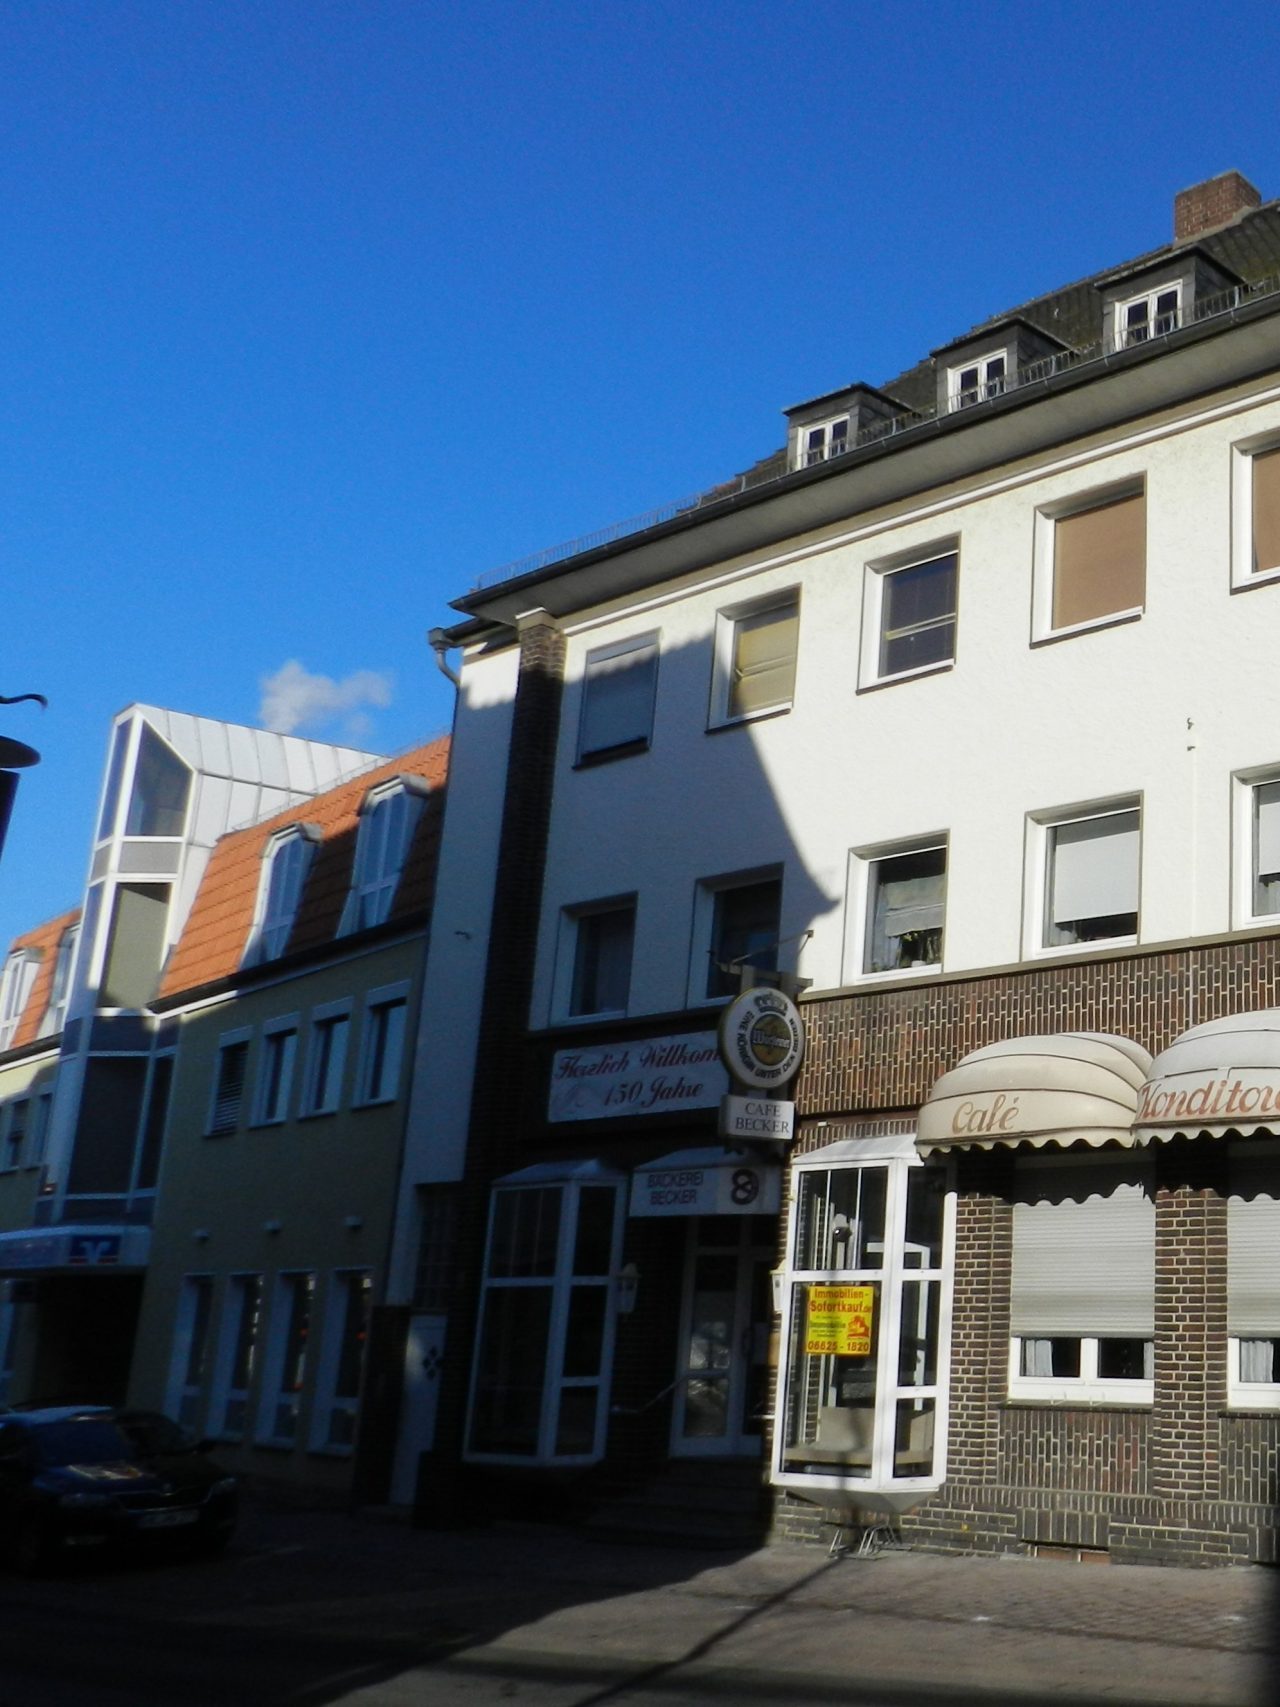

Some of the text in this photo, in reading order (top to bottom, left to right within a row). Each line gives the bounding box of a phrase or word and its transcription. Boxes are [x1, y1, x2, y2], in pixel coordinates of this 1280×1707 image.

[554, 1043, 721, 1080] Herzlich Willkom
[754, 1066, 782, 1080] UNTER
[603, 1075, 704, 1108] 150 Jahre
[744, 1102, 782, 1118] CAFE
[951, 1093, 1020, 1135] Café
[735, 1116, 790, 1134] BECKER
[649, 1189, 697, 1205] BECKER
[847, 1341, 870, 1352] 1820
